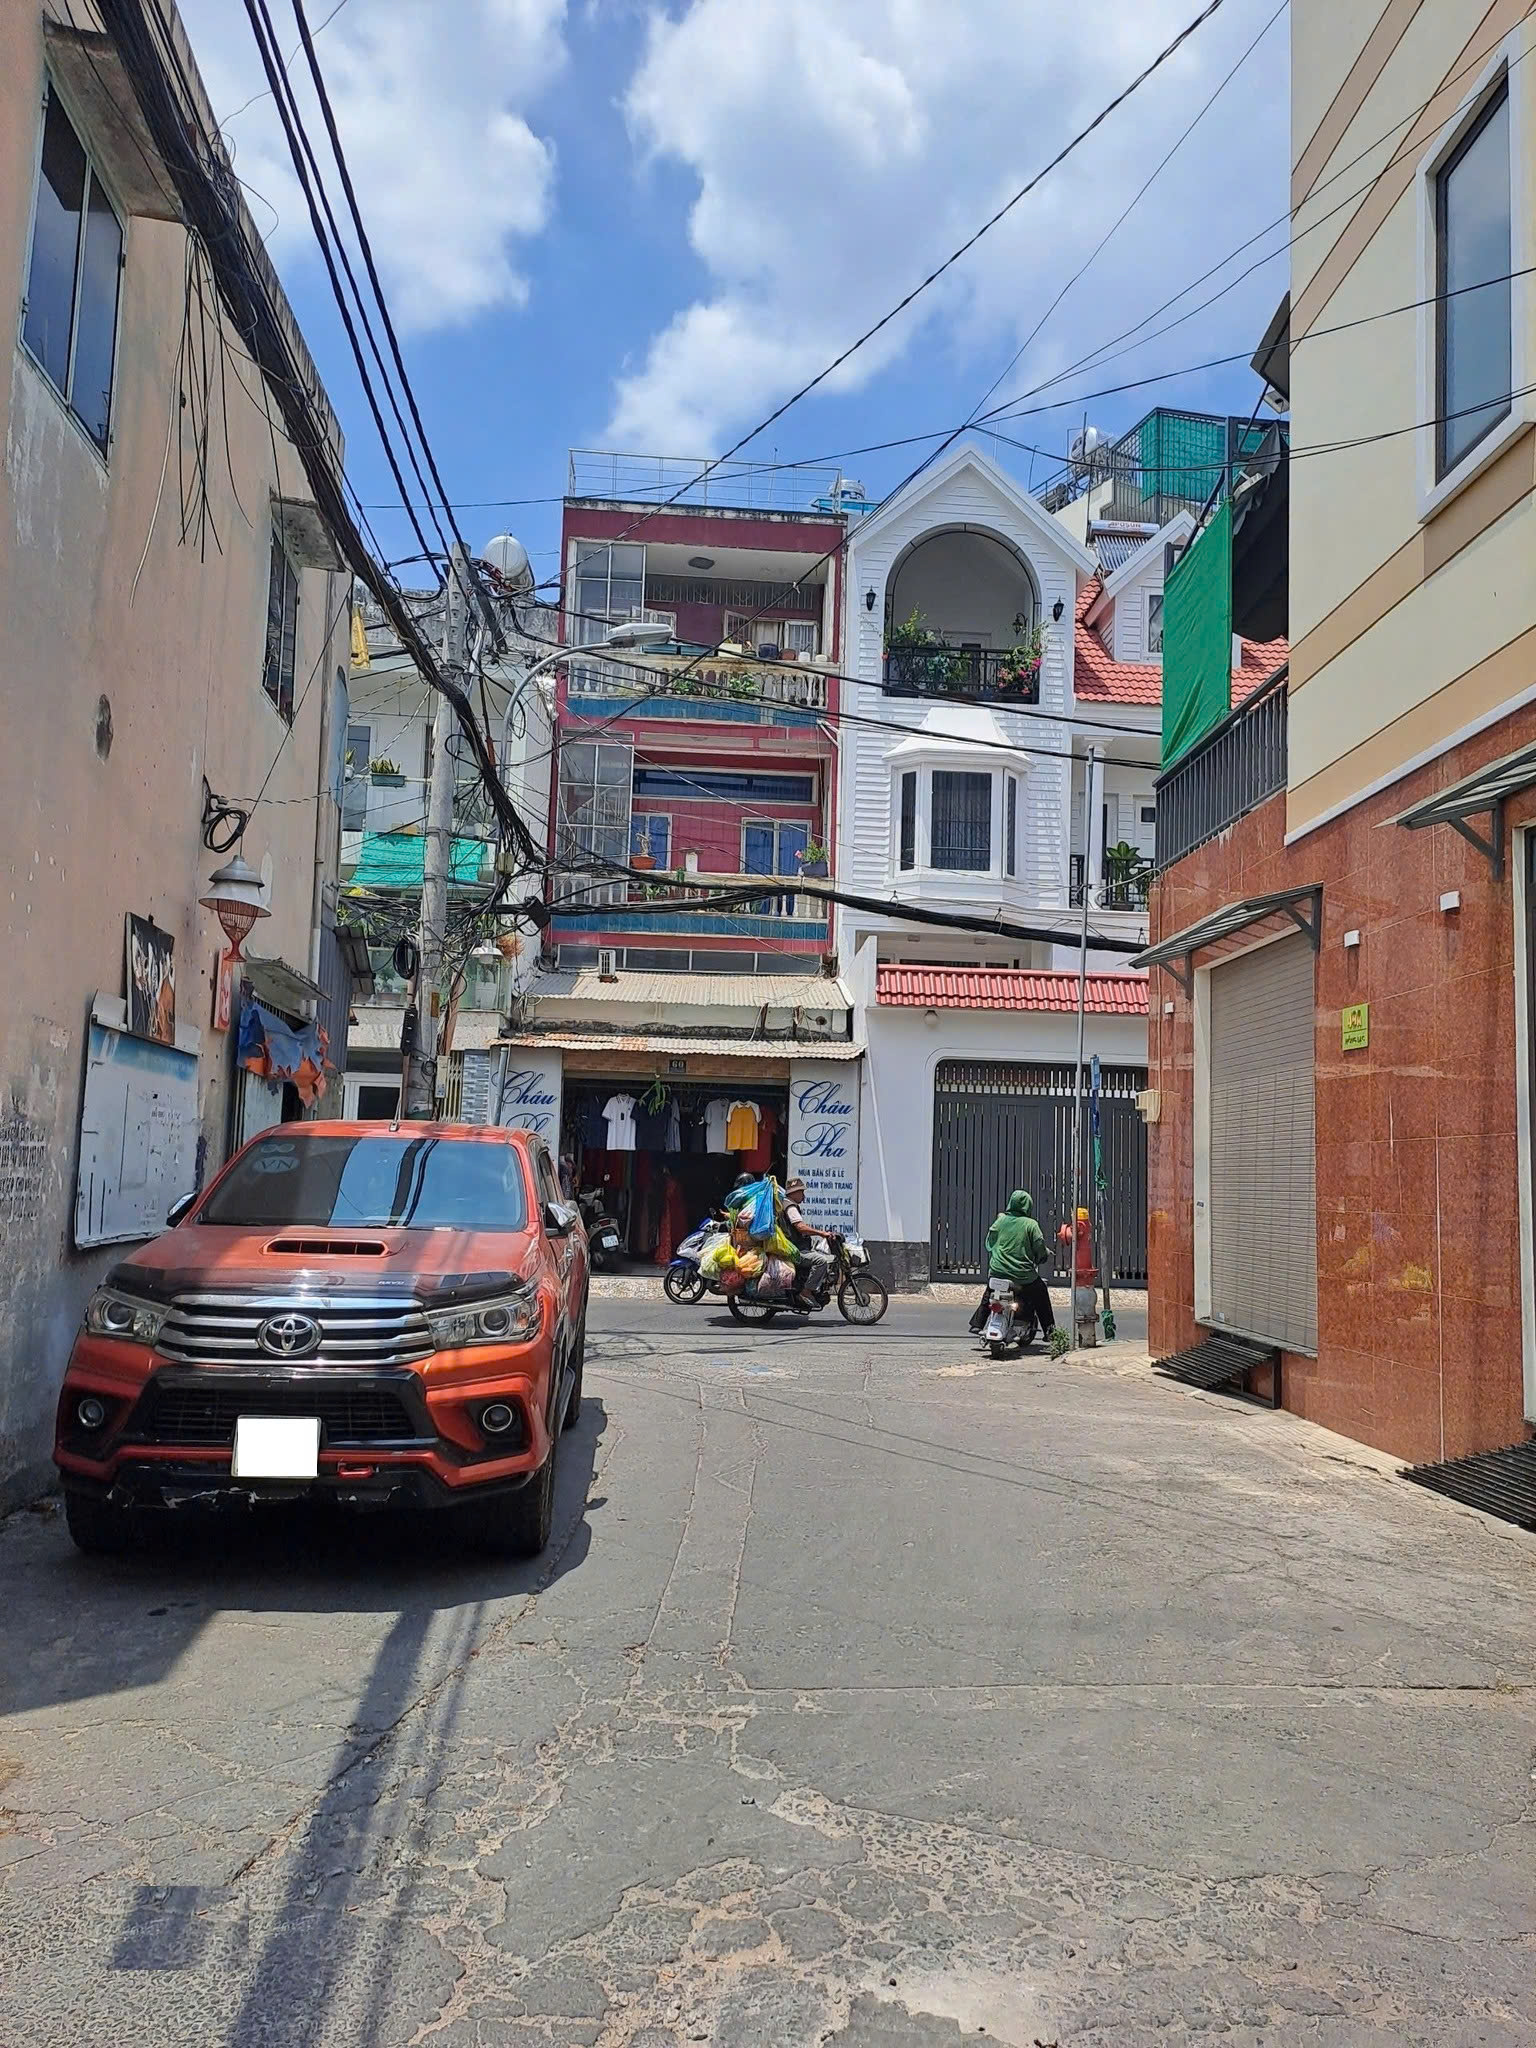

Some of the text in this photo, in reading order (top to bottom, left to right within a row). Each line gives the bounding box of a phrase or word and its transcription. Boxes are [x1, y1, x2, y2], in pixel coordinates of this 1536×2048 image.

[672, 1060, 684, 1068] 60
[491, 1070, 557, 1112] Châu
[791, 1080, 854, 1120] Châu
[791, 1122, 851, 1157] Pha
[835, 1182, 853, 1190] TRANG
[840, 1209, 854, 1217] SALE
